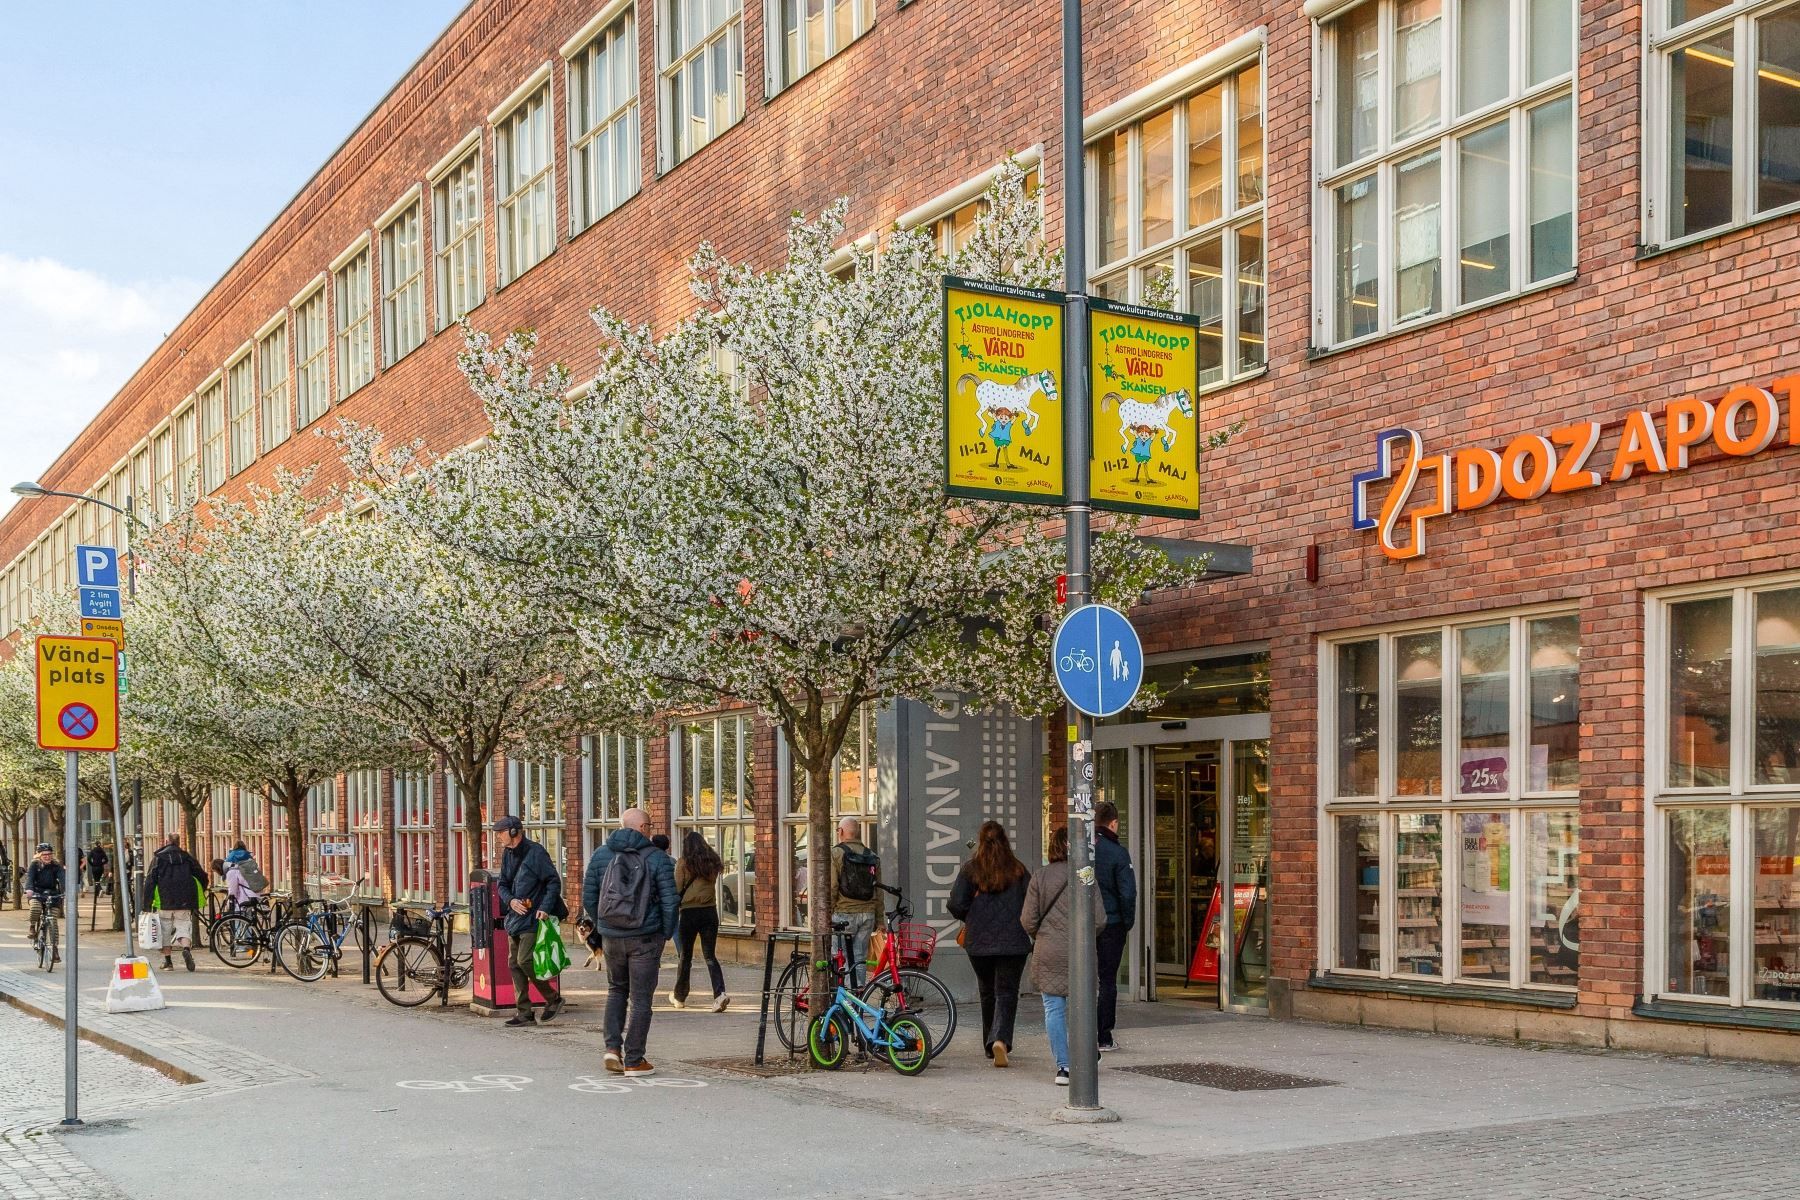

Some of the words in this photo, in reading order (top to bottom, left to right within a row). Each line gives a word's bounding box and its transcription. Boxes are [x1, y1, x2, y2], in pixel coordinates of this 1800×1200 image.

[963, 280, 1046, 299] www.kulturtavlorna.se
[954, 303, 1054, 330] TJOLAHOPP
[1107, 303, 1183, 322] www.kulturtavlorna.se
[972, 323, 996, 334] ASTRID
[997, 327, 1035, 340] LINDGRENS
[1099, 324, 1190, 351] TJOLAHOPP
[983, 337, 1025, 359] VÄRLD
[1115, 343, 1137, 356] ASTRID
[1137, 347, 1173, 361] LINDGRENS
[978, 362, 1028, 376] SKANSEN
[1125, 357, 1164, 378] VÄRLD
[1120, 381, 1167, 395] SKANSEN
[960, 442, 988, 457] 11-12
[1019, 446, 1050, 467] MAJ
[1103, 458, 1129, 472] 11-12
[1159, 461, 1187, 481] MAJ
[1457, 421, 1601, 511] DOZ
[85, 550, 109, 582] P
[89, 600, 112, 608] Avgift
[41, 644, 113, 664] Vänd-
[49, 666, 106, 686] plats
[1471, 767, 1498, 788] 25%
[1237, 794, 1253, 806] Hej!
